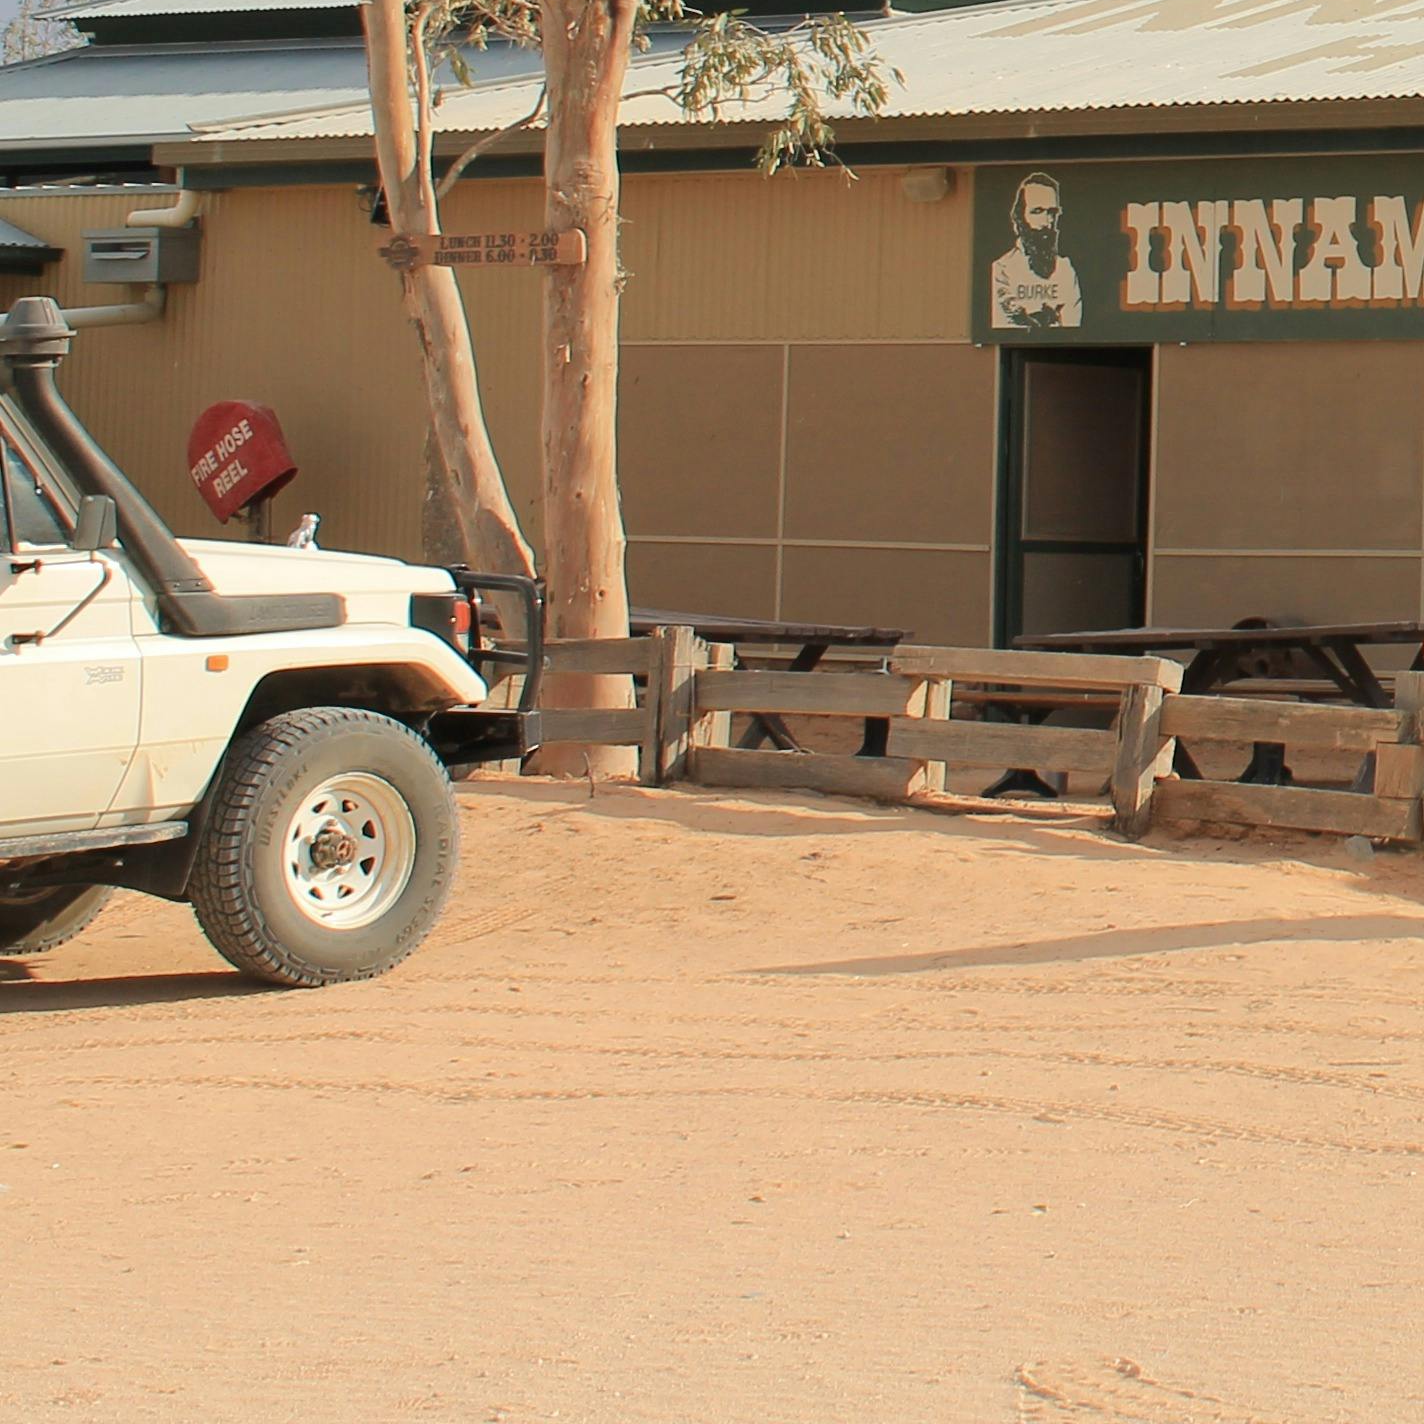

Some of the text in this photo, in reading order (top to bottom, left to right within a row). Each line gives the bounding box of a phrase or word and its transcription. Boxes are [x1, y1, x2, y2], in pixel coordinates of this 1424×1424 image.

[440, 236, 481, 250] LUNCH
[434, 250, 482, 264] DINNER
[1018, 284, 1058, 299] BURKE
[191, 419, 254, 487] FIRE HOSE
[213, 459, 248, 498] REEL
